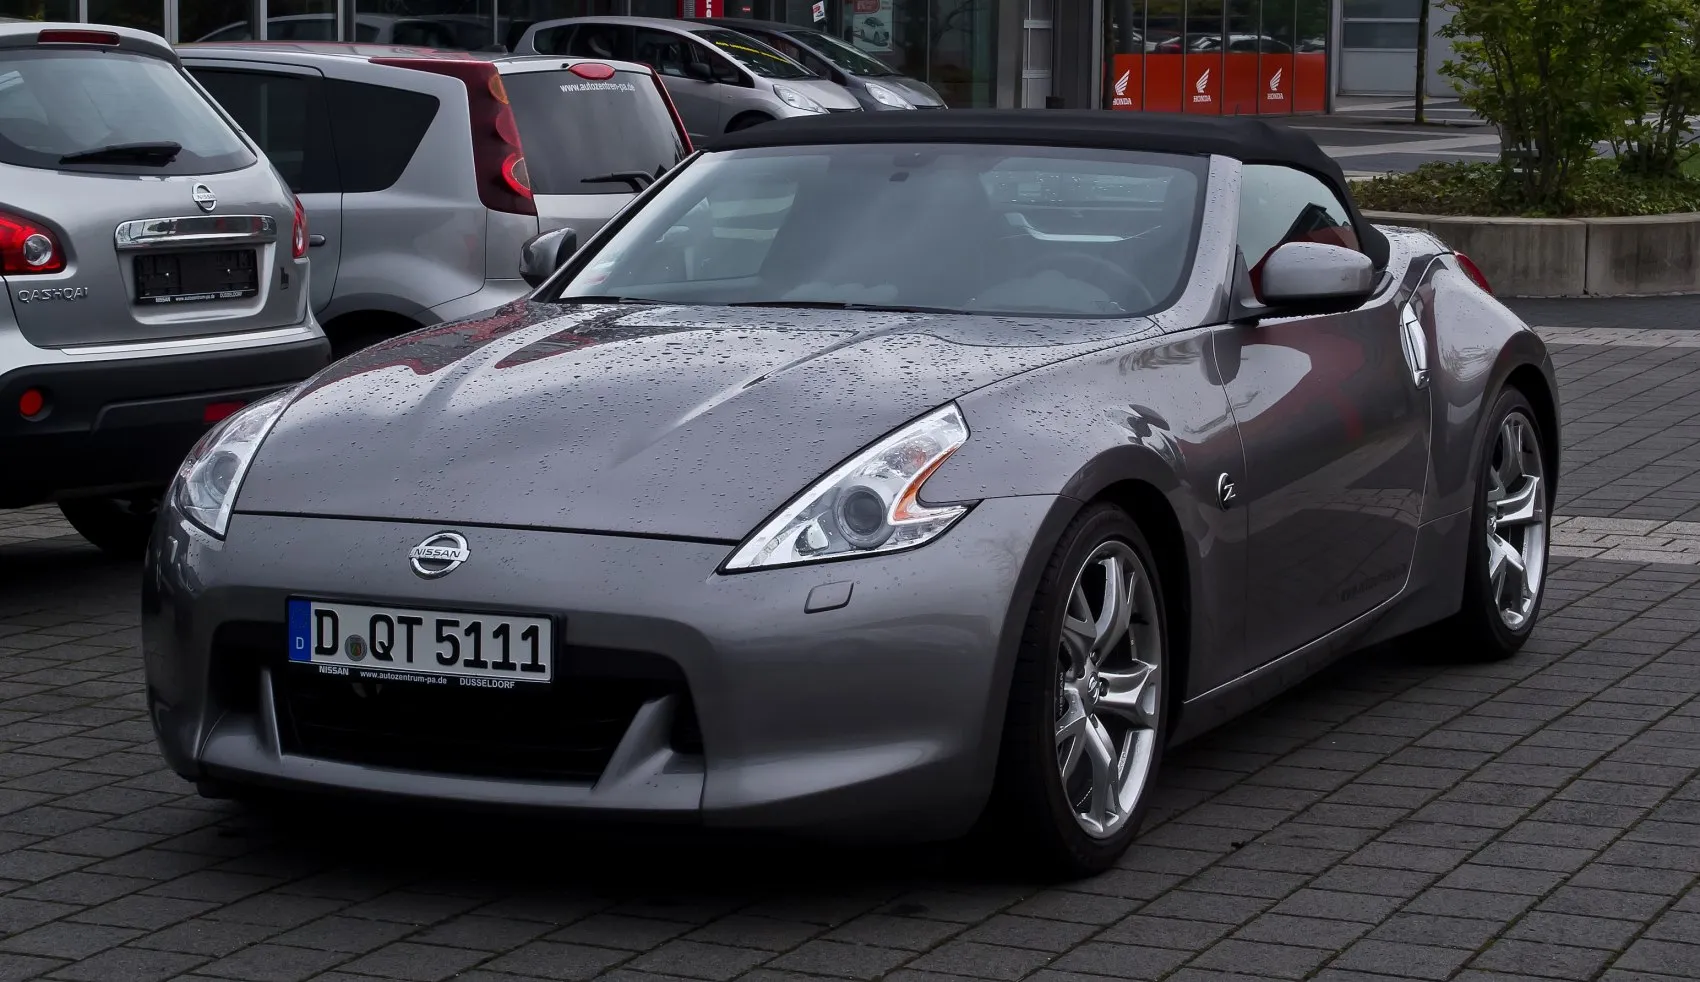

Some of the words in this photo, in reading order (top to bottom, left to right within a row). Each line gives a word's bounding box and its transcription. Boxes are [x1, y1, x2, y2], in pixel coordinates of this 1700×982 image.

[1193, 95, 1212, 103] HONDA
[1267, 92, 1284, 100] HONDA
[18, 287, 88, 303] QASHQAI
[413, 548, 461, 558] NISSAN
[296, 636, 305, 650] D
[314, 608, 340, 656] D
[369, 613, 424, 663] QT
[435, 618, 546, 674] 5111
[318, 665, 350, 677] NISSAN
[360, 670, 448, 685] www.autozentrum-pa.de
